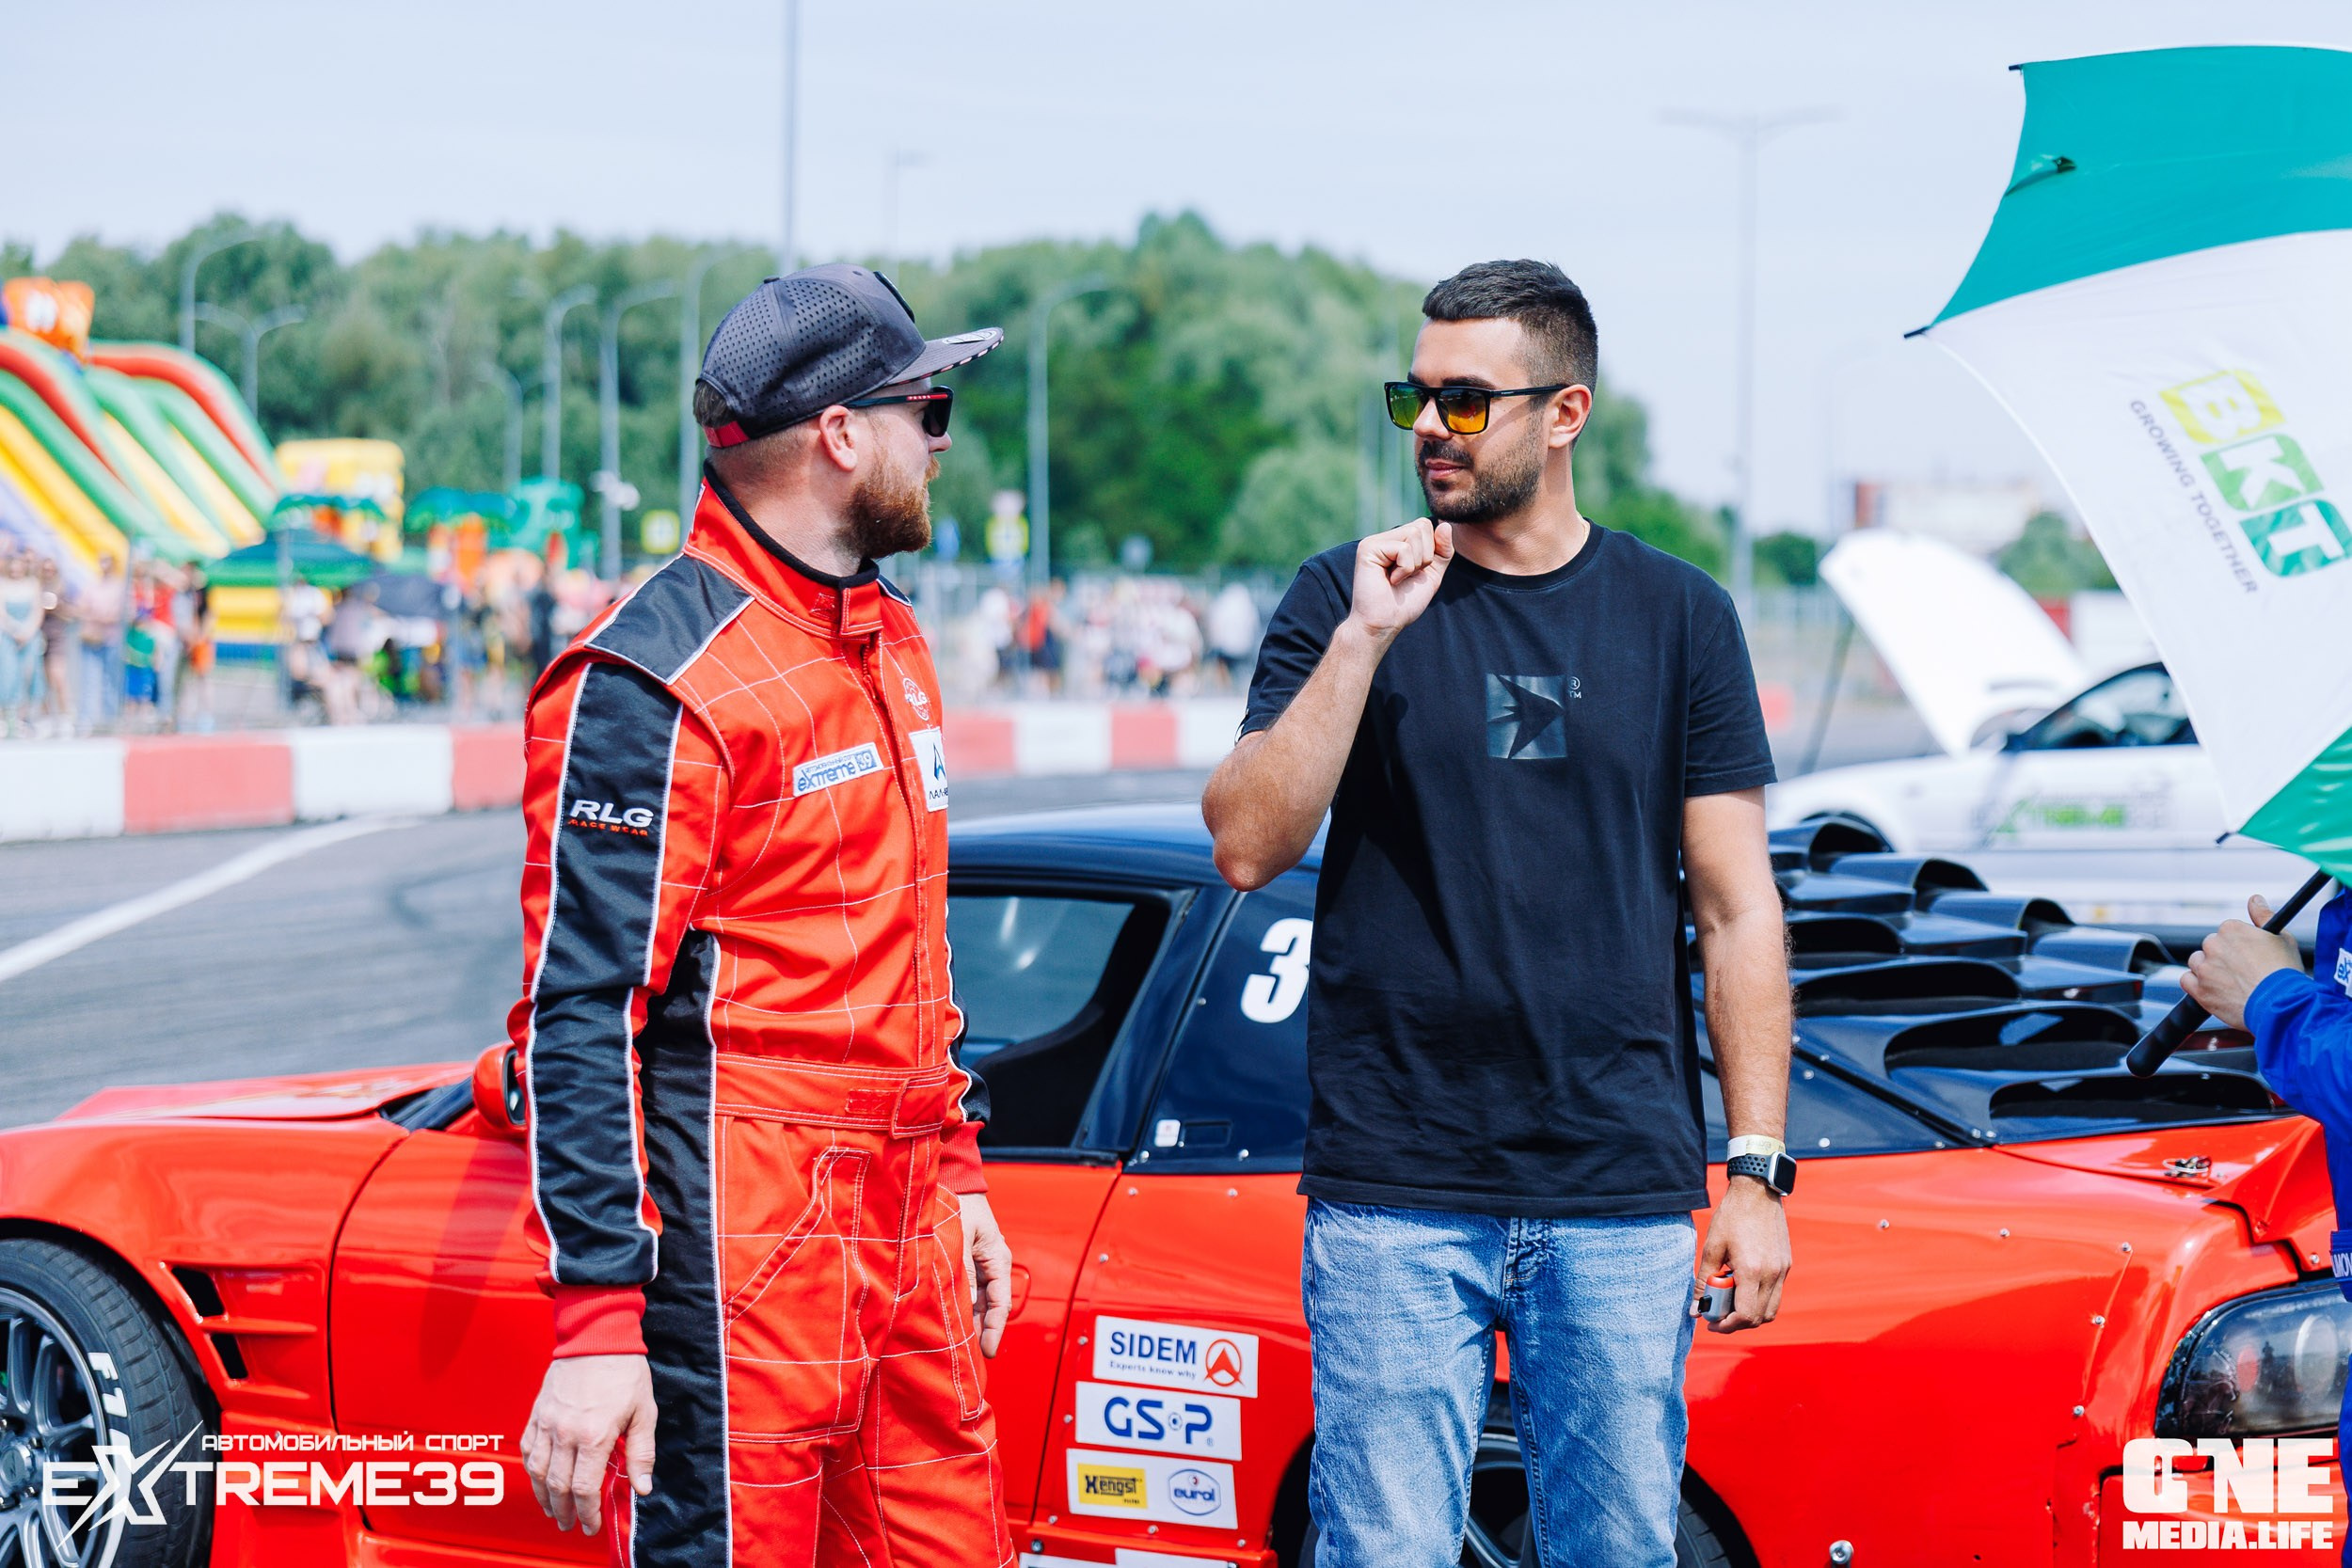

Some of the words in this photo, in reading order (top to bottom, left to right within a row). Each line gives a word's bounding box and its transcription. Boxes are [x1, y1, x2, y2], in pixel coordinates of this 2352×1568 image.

[2167, 371, 2348, 569] BKT
[2130, 400, 2195, 487] GROWING
[2191, 492, 2257, 594] TOGETHER
[567, 818, 607, 830] RACE
[610, 825, 648, 837] WEAR
[569, 800, 654, 828] RLG
[1241, 917, 1313, 1023] 3
[1110, 1331, 1197, 1365] SIDEM
[1110, 1360, 1146, 1373] Experts
[1150, 1366, 1174, 1375] know
[1178, 1370, 1197, 1380] why
[1085, 1474, 1136, 1497] Hengst
[1173, 1487, 1216, 1502] eurol
